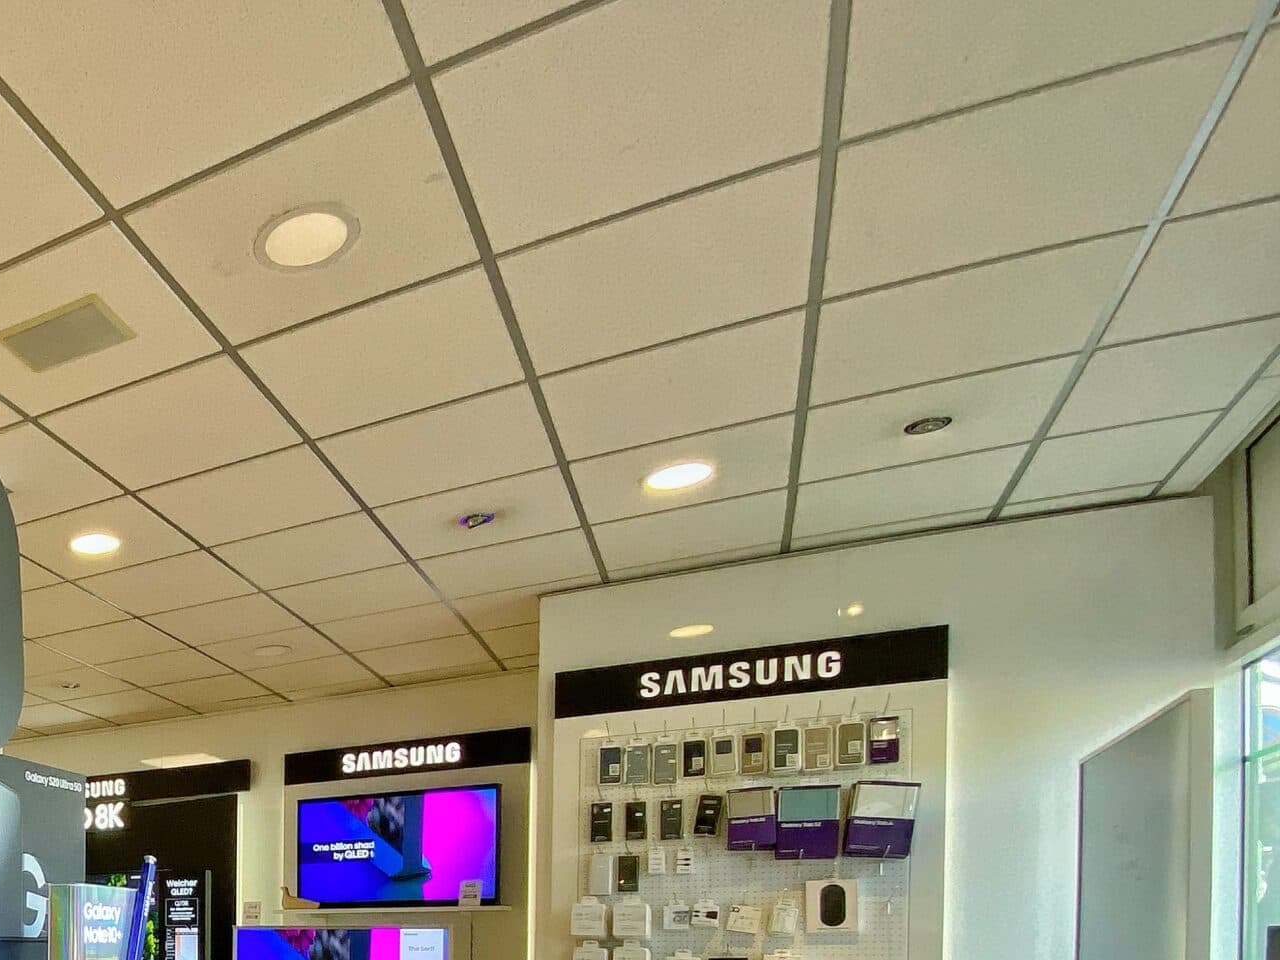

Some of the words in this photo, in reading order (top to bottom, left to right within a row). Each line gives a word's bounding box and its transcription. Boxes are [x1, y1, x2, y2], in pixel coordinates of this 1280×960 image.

[640, 651, 841, 698] SAMSUNG
[342, 742, 461, 773] SAMSUNG
[25, 771, 48, 787] Galaxy
[49, 776, 60, 788] S20
[60, 779, 73, 790] Ultra
[95, 802, 124, 830] 8K
[312, 844, 330, 852] One
[330, 842, 353, 851] billion
[333, 852, 344, 861] by
[344, 850, 370, 859] QLED
[166, 879, 198, 888] Welcher
[84, 900, 121, 924] Galaxy
[84, 926, 123, 944] Note10+
